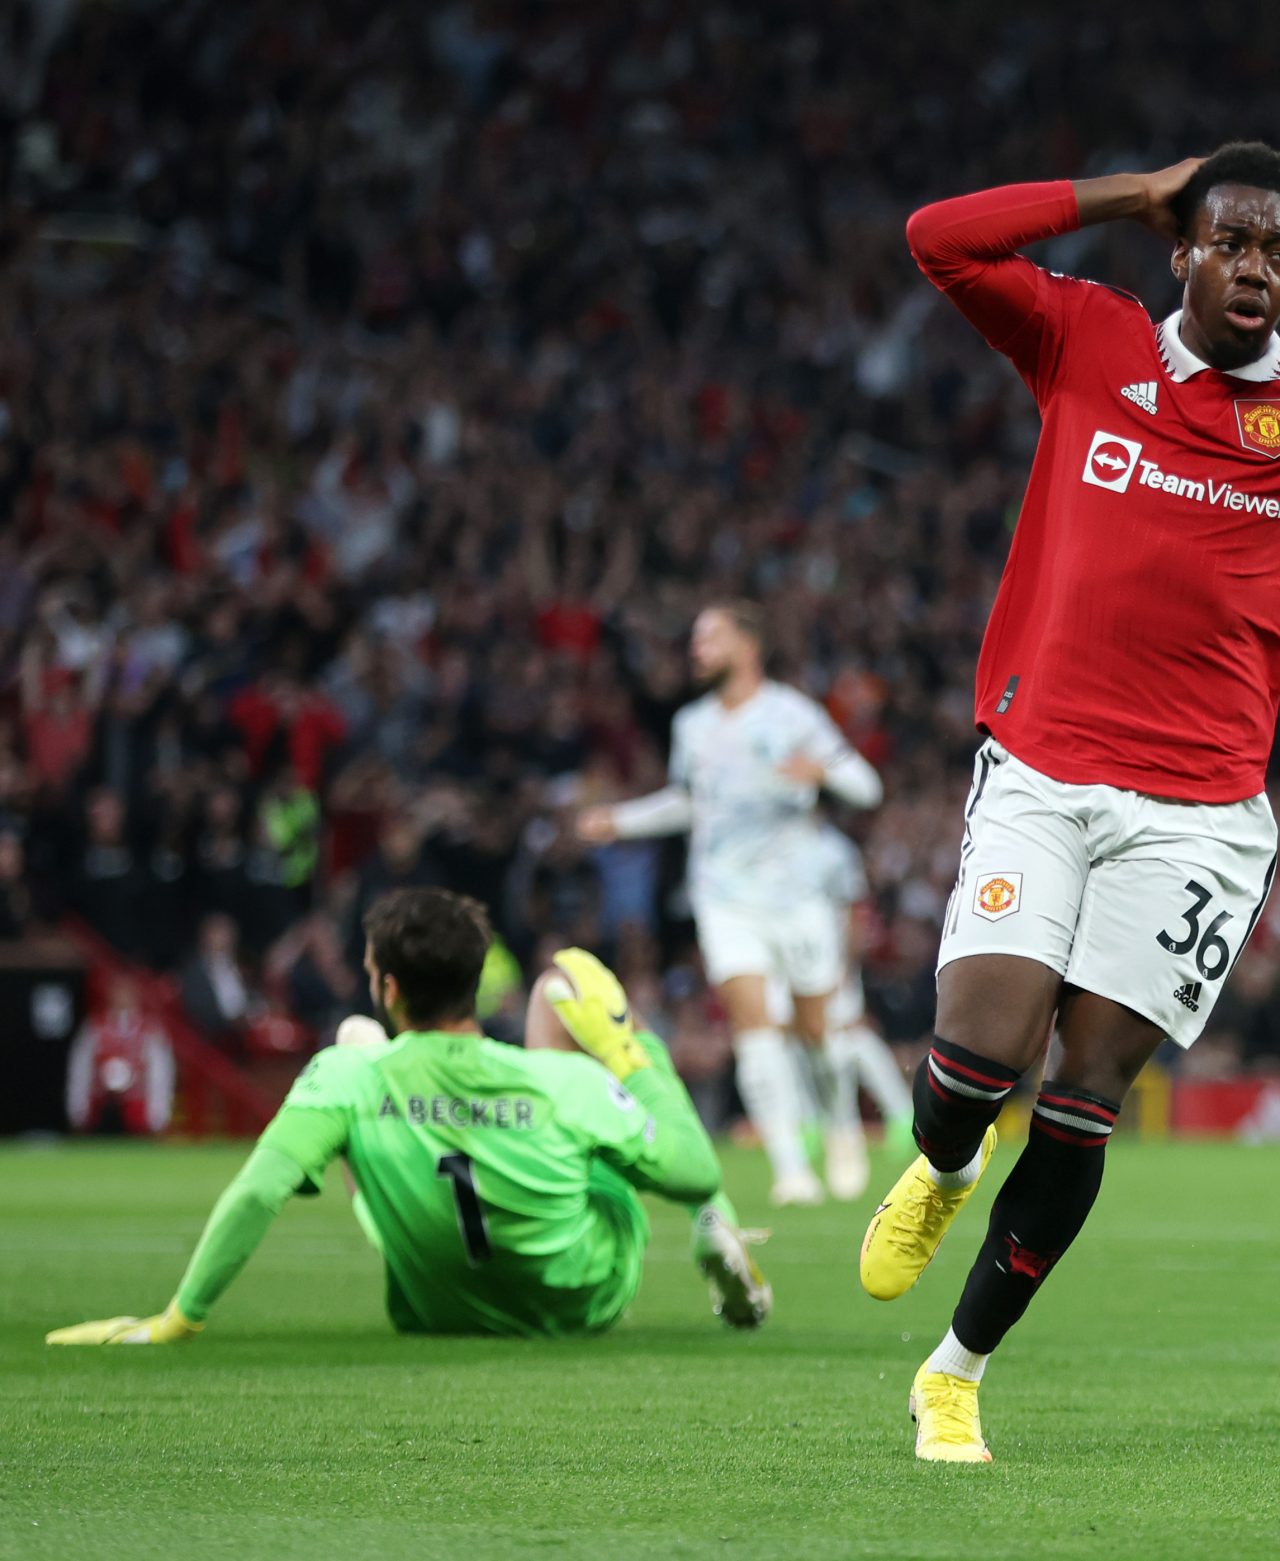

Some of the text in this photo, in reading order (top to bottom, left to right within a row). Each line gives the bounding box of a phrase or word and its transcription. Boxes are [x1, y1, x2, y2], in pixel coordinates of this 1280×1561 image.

[1120, 386, 1158, 415] adidas
[1155, 879, 1235, 981] 36
[1173, 988, 1200, 1013] adidas
[408, 1096, 535, 1129] BECKER
[436, 1155, 493, 1267] 1
